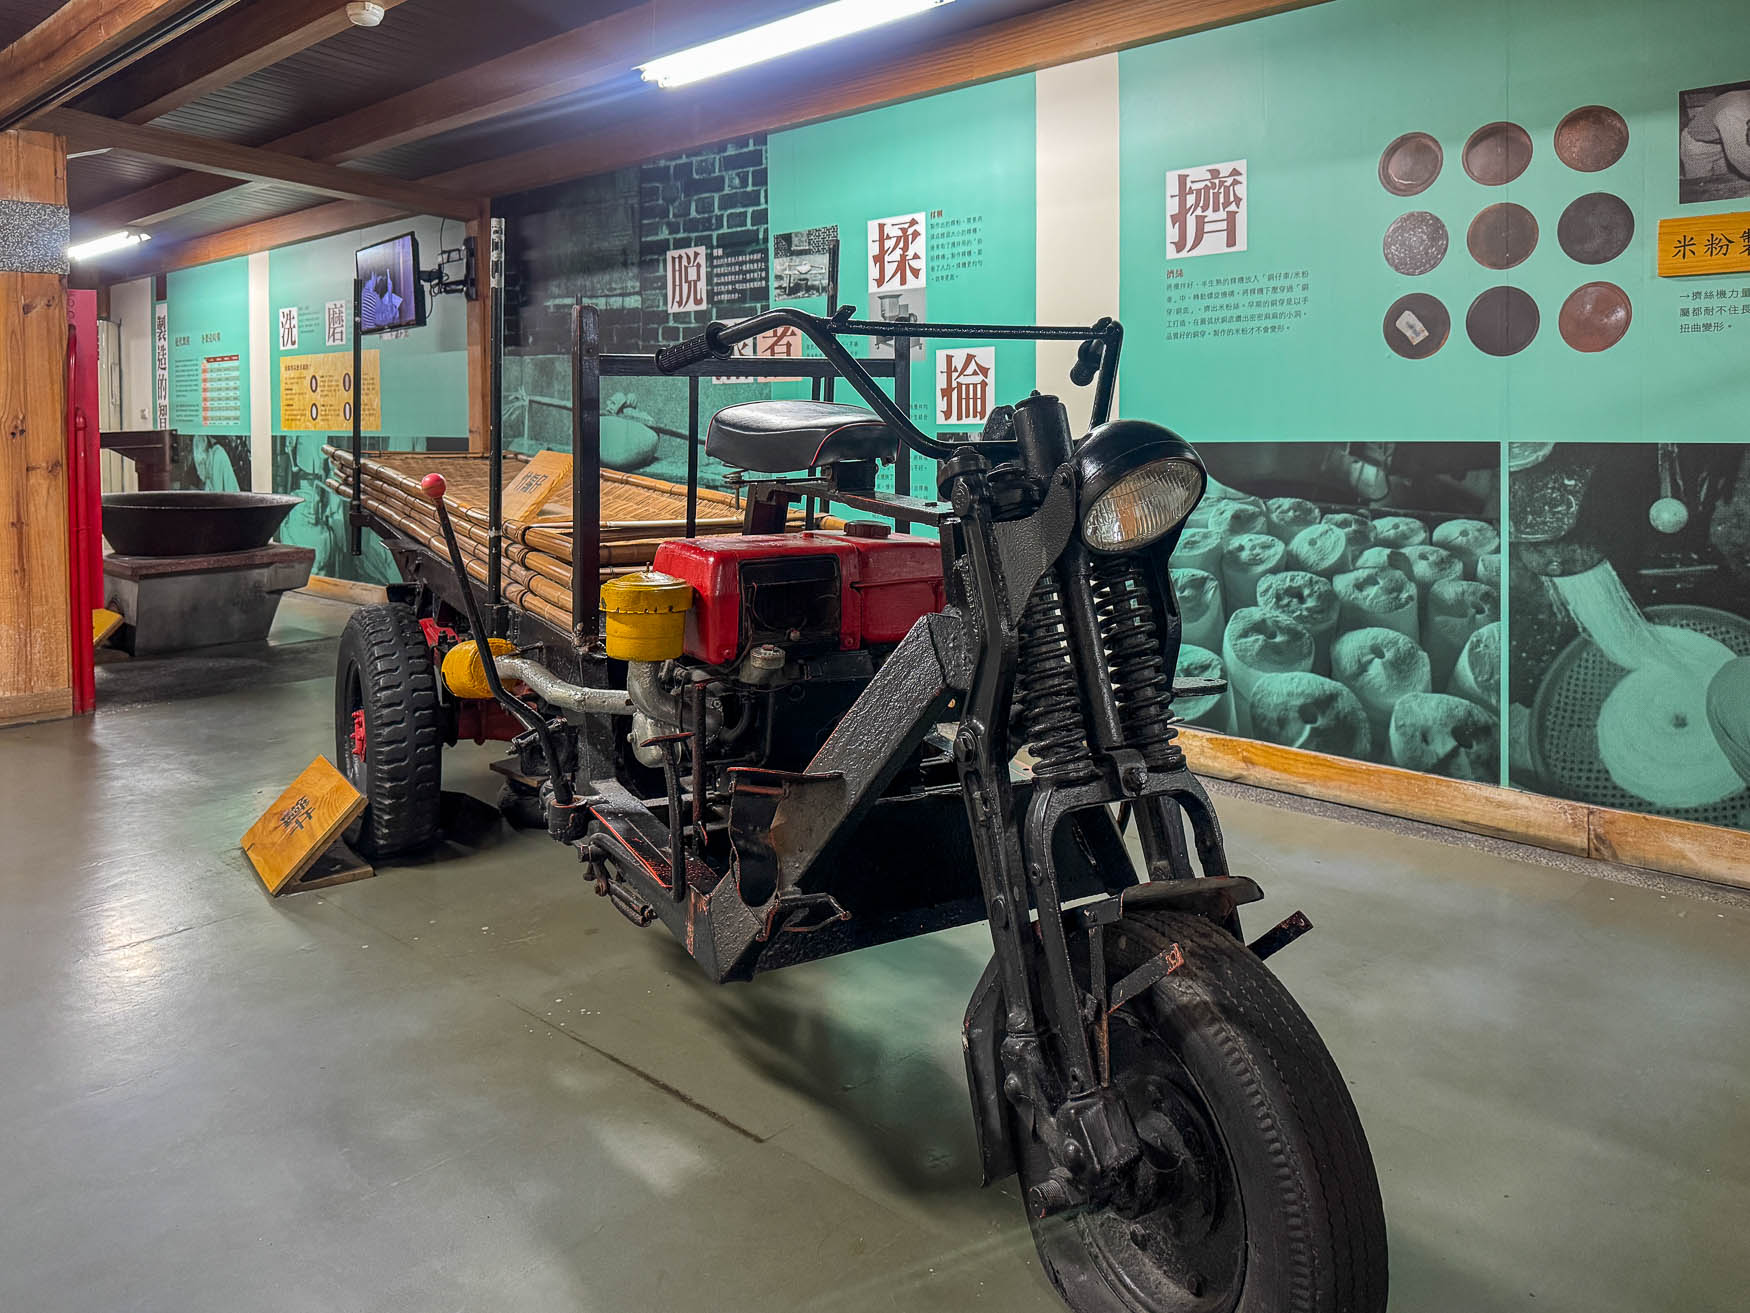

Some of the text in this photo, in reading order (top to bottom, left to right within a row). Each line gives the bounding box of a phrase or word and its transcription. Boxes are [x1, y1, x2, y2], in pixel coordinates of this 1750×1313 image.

[1170, 168, 1243, 253] 擠
[872, 218, 921, 288] 揉
[281, 309, 296, 347] 洗
[327, 303, 344, 343] 磨
[940, 353, 991, 421] 掄
